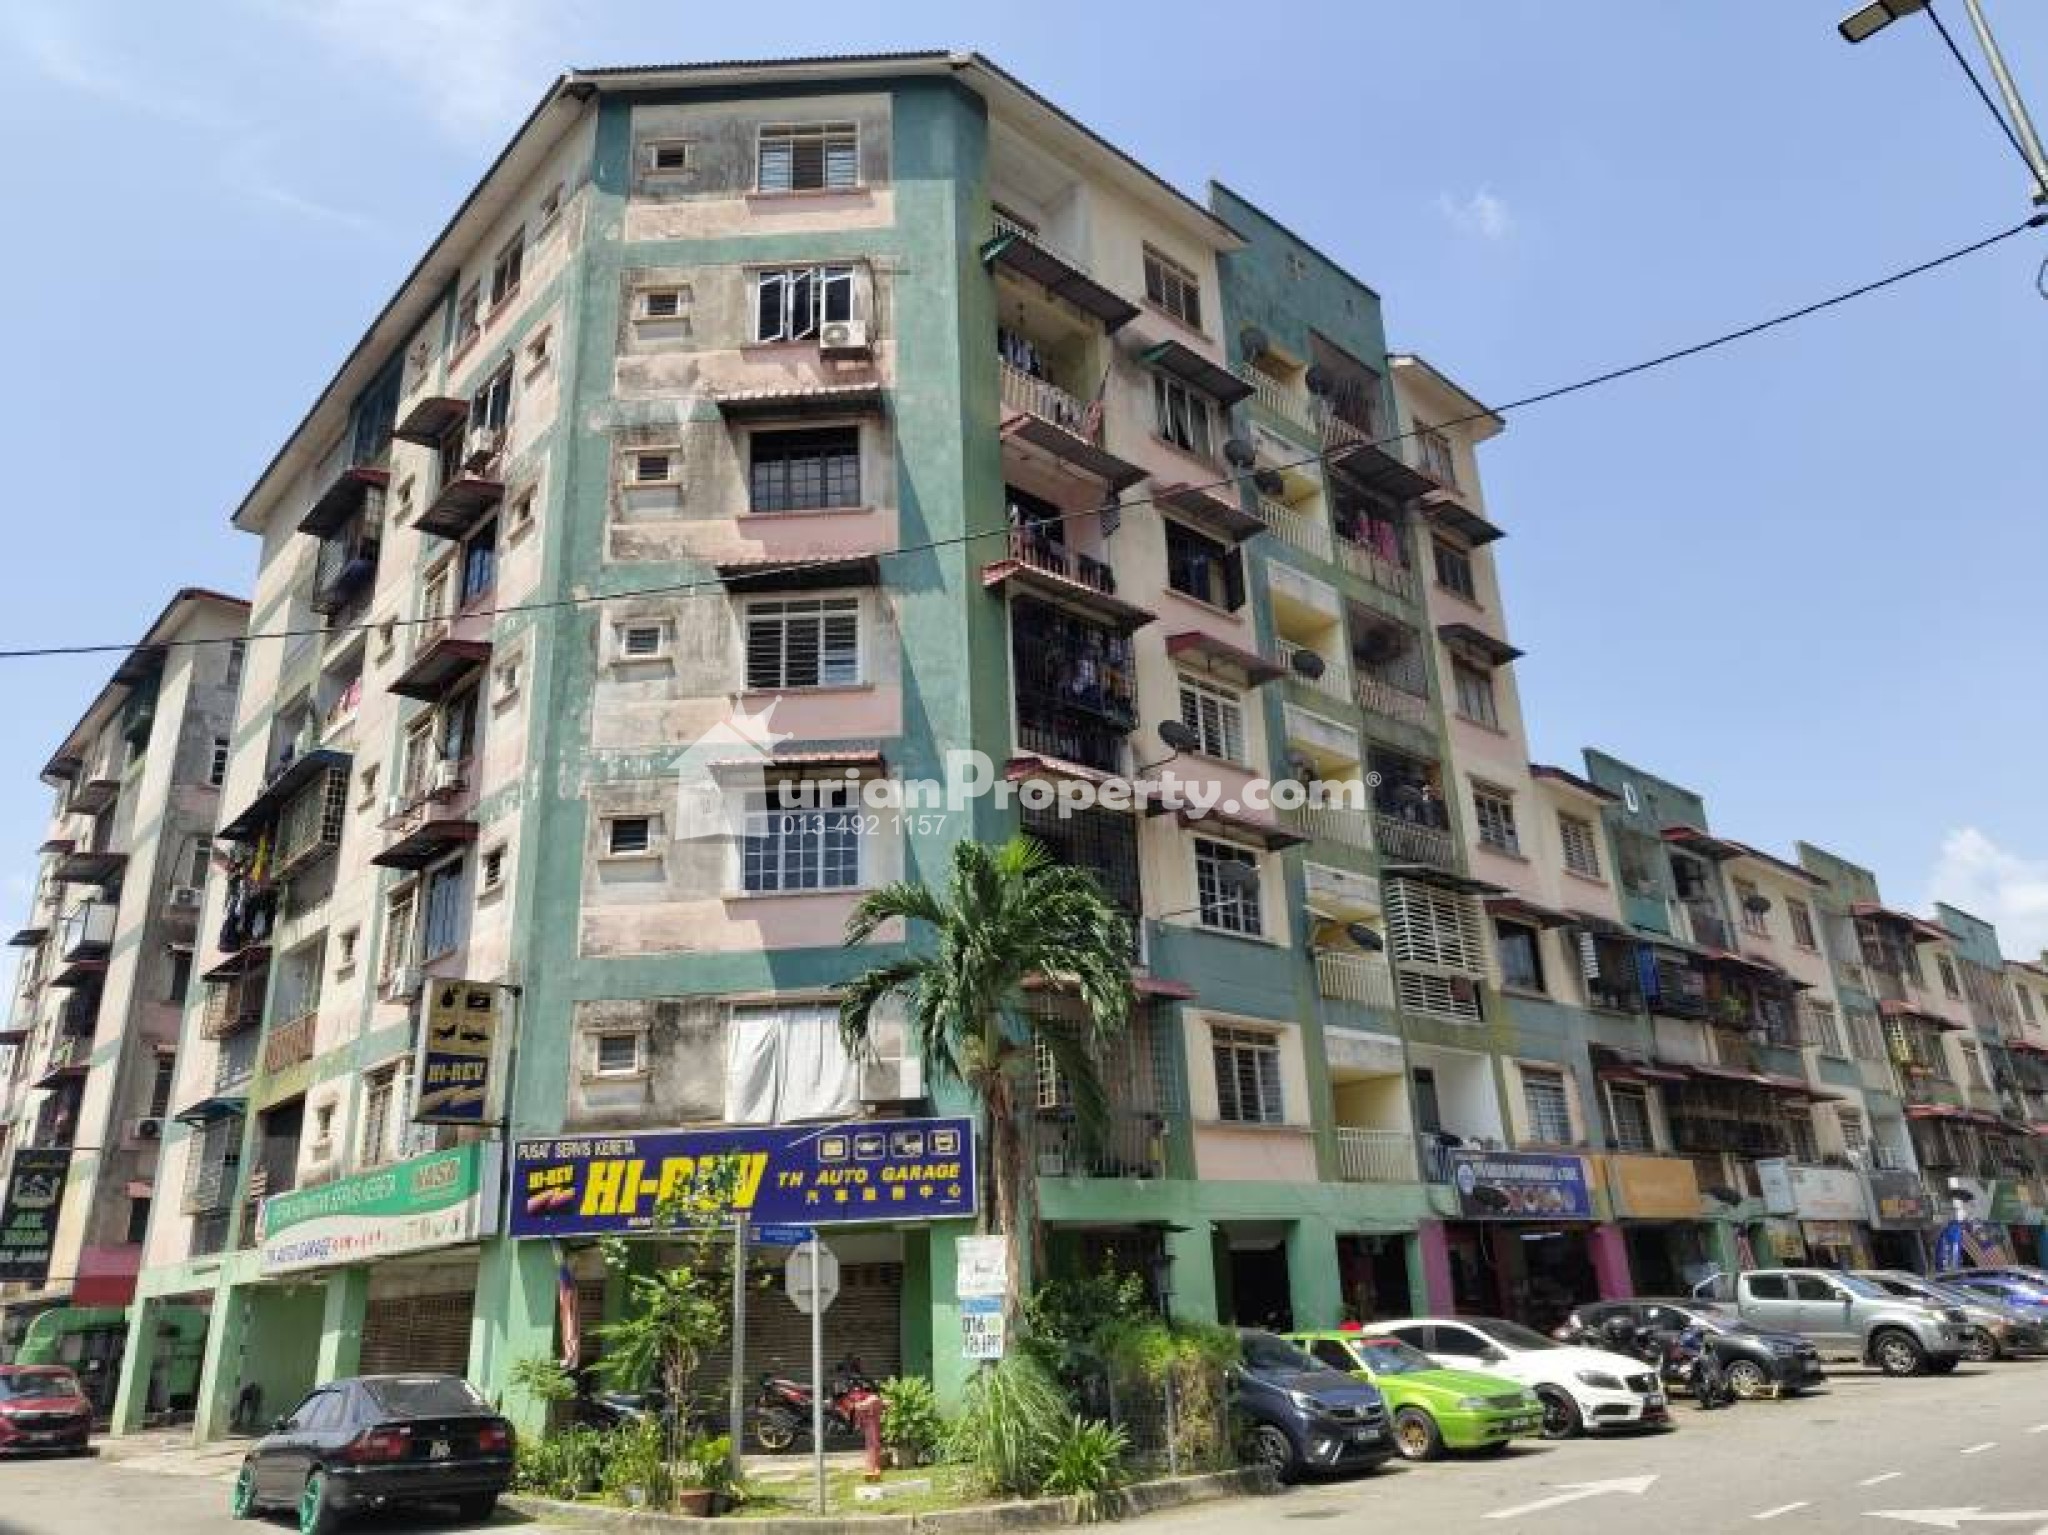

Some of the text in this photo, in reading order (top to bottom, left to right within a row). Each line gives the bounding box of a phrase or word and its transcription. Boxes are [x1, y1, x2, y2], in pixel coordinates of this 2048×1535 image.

[428, 1061, 484, 1083] HI-REV
[518, 1139, 636, 1160] PUSAT SERVIS KERETA
[528, 1165, 574, 1188] HI-REV
[777, 1162, 961, 1188] TH AUTO GARAGE
